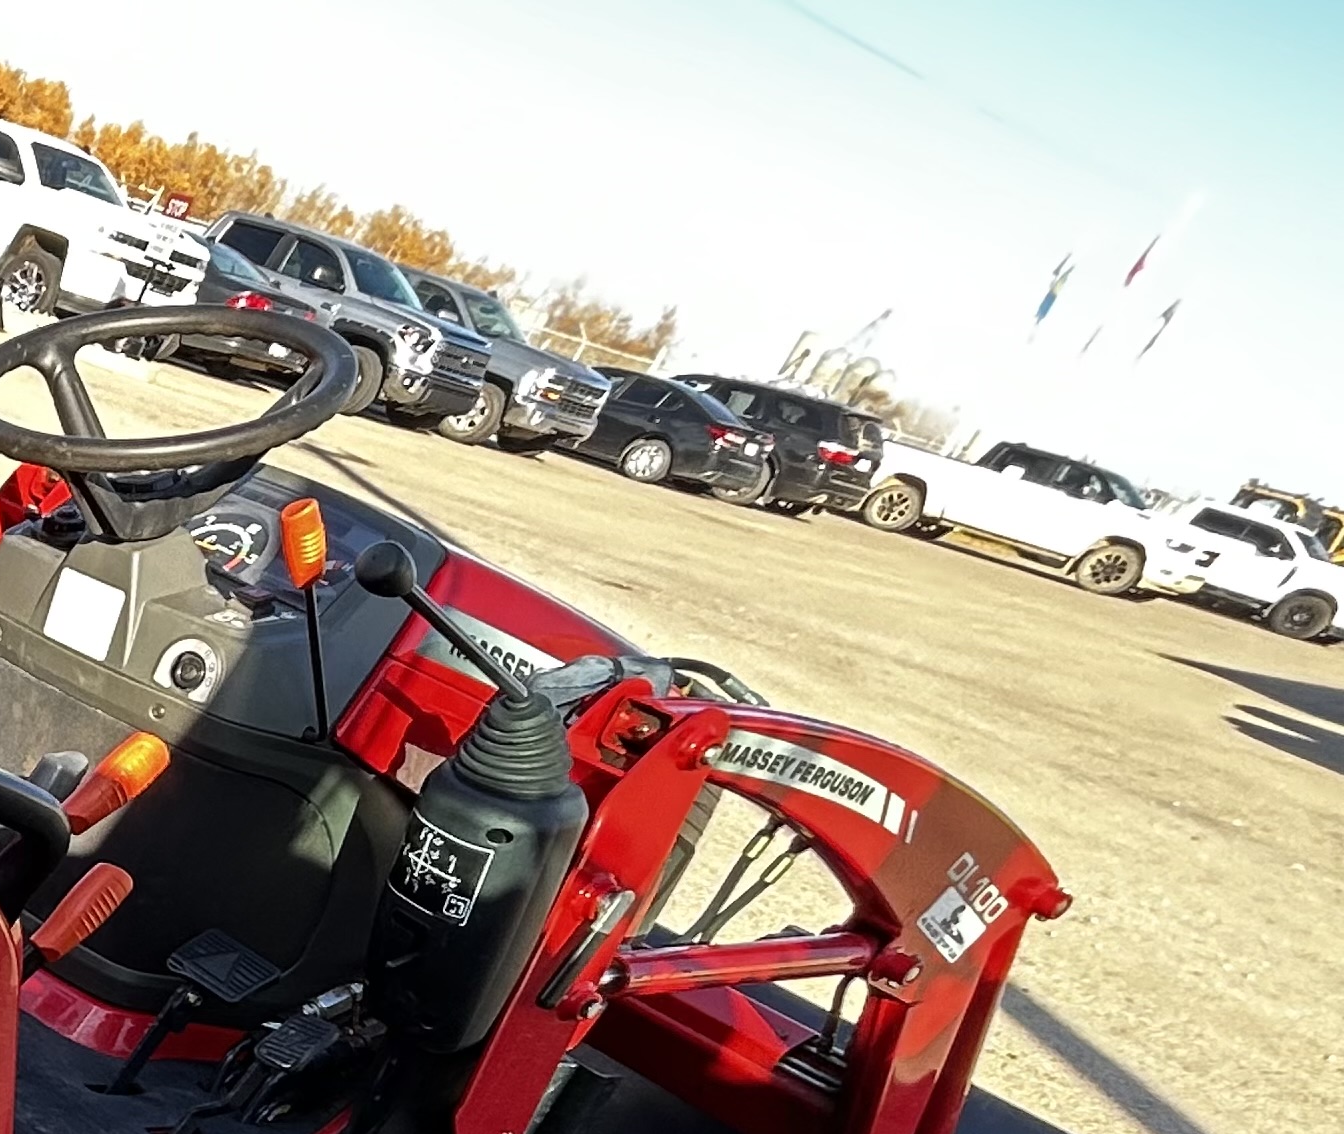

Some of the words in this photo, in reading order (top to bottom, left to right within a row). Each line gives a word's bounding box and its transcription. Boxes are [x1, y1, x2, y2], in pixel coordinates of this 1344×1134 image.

[449, 634, 535, 683] SSE
[718, 742, 797, 777] MASSEY
[789, 760, 876, 806] FERGUSON
[947, 851, 1009, 924] DL100
